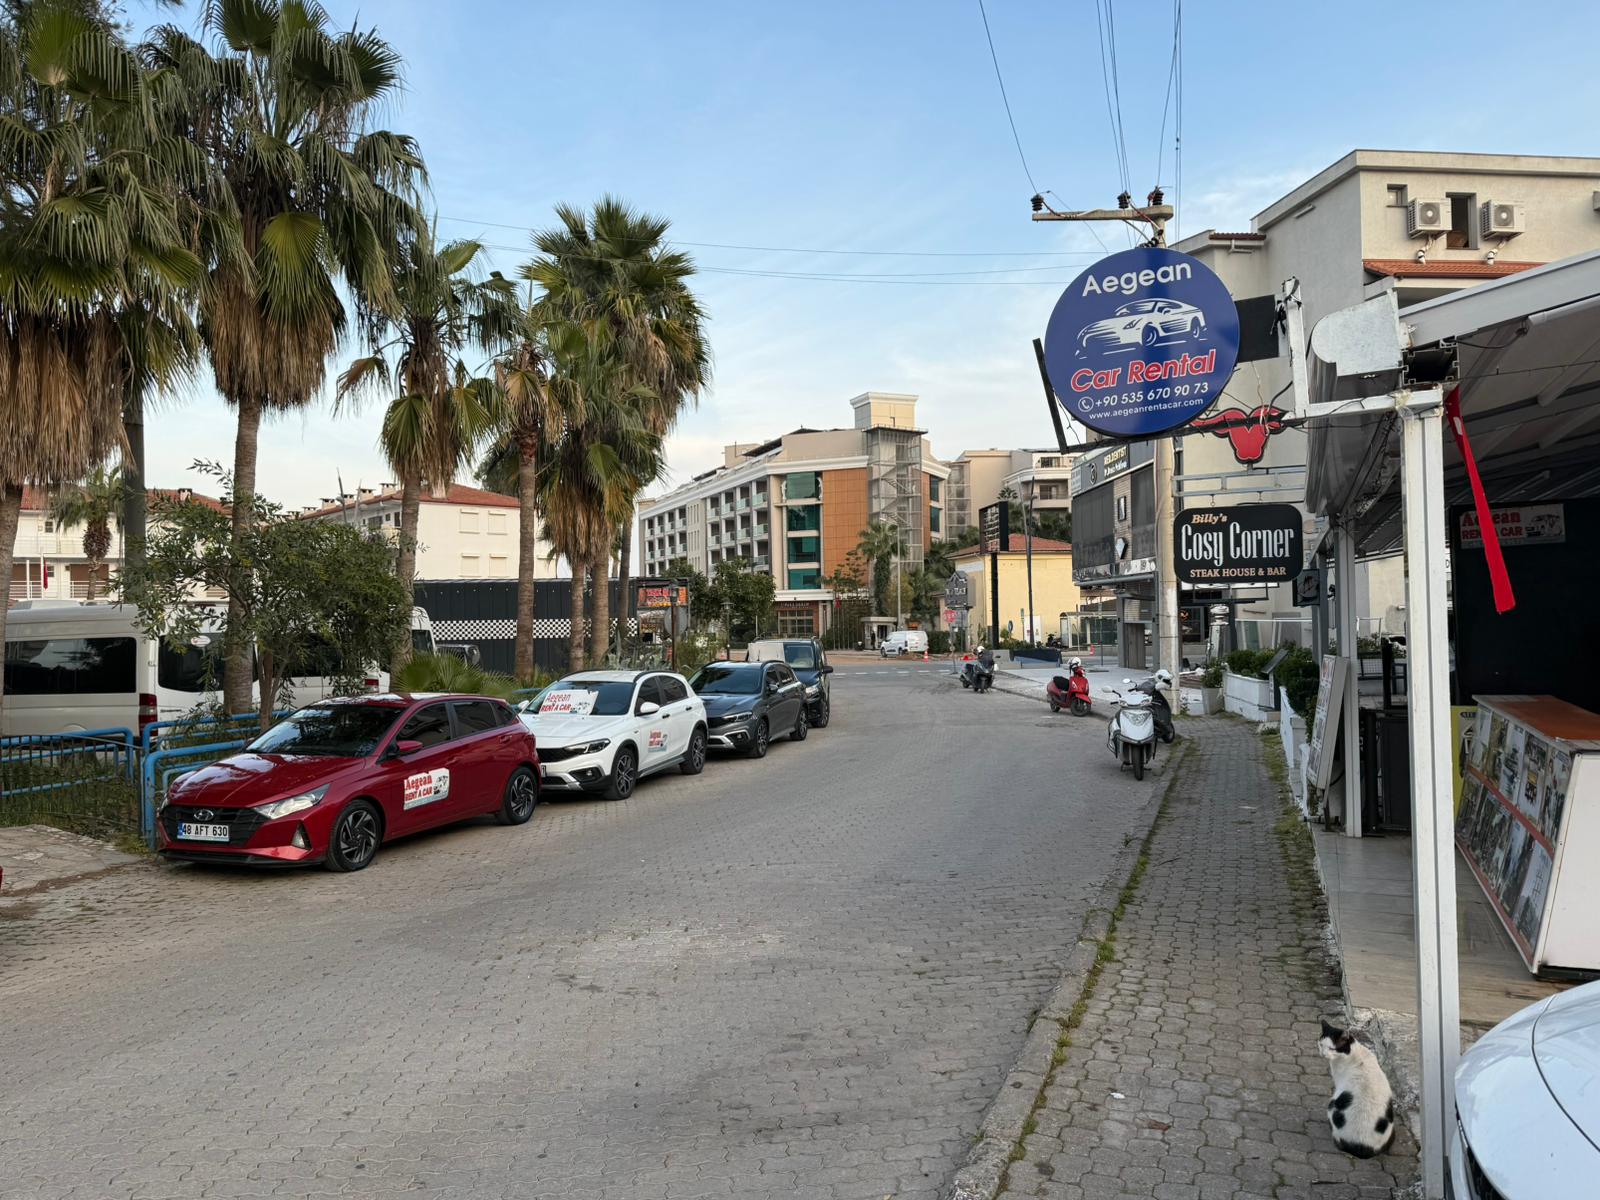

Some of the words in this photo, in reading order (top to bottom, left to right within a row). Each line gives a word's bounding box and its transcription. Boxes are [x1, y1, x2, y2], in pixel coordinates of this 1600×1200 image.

[1082, 262, 1192, 297] Aegean
[1071, 367, 1122, 392] Car
[1127, 349, 1217, 385] Rental
[1095, 395, 1118, 407] +90
[1121, 391, 1144, 404] 535
[1147, 387, 1171, 400] 670
[1174, 384, 1190, 396] 90
[1194, 382, 1209, 394] 73
[1088, 398, 1204, 420] www.aegeanrentacar.com
[1191, 513, 1228, 525] Billy's
[1462, 511, 1521, 527] Aean
[1501, 526, 1523, 537] CAR
[1181, 523, 1224, 567] Cosy
[1229, 521, 1295, 559] Corner
[1190, 568, 1221, 578] STEAK
[1222, 567, 1256, 577] HOUSE
[1258, 567, 1265, 576] &
[1267, 566, 1287, 576] BAR
[406, 775, 432, 790] Aegean
[182, 824, 191, 834] 48
[195, 825, 209, 836] AFT
[212, 826, 228, 837] 630
